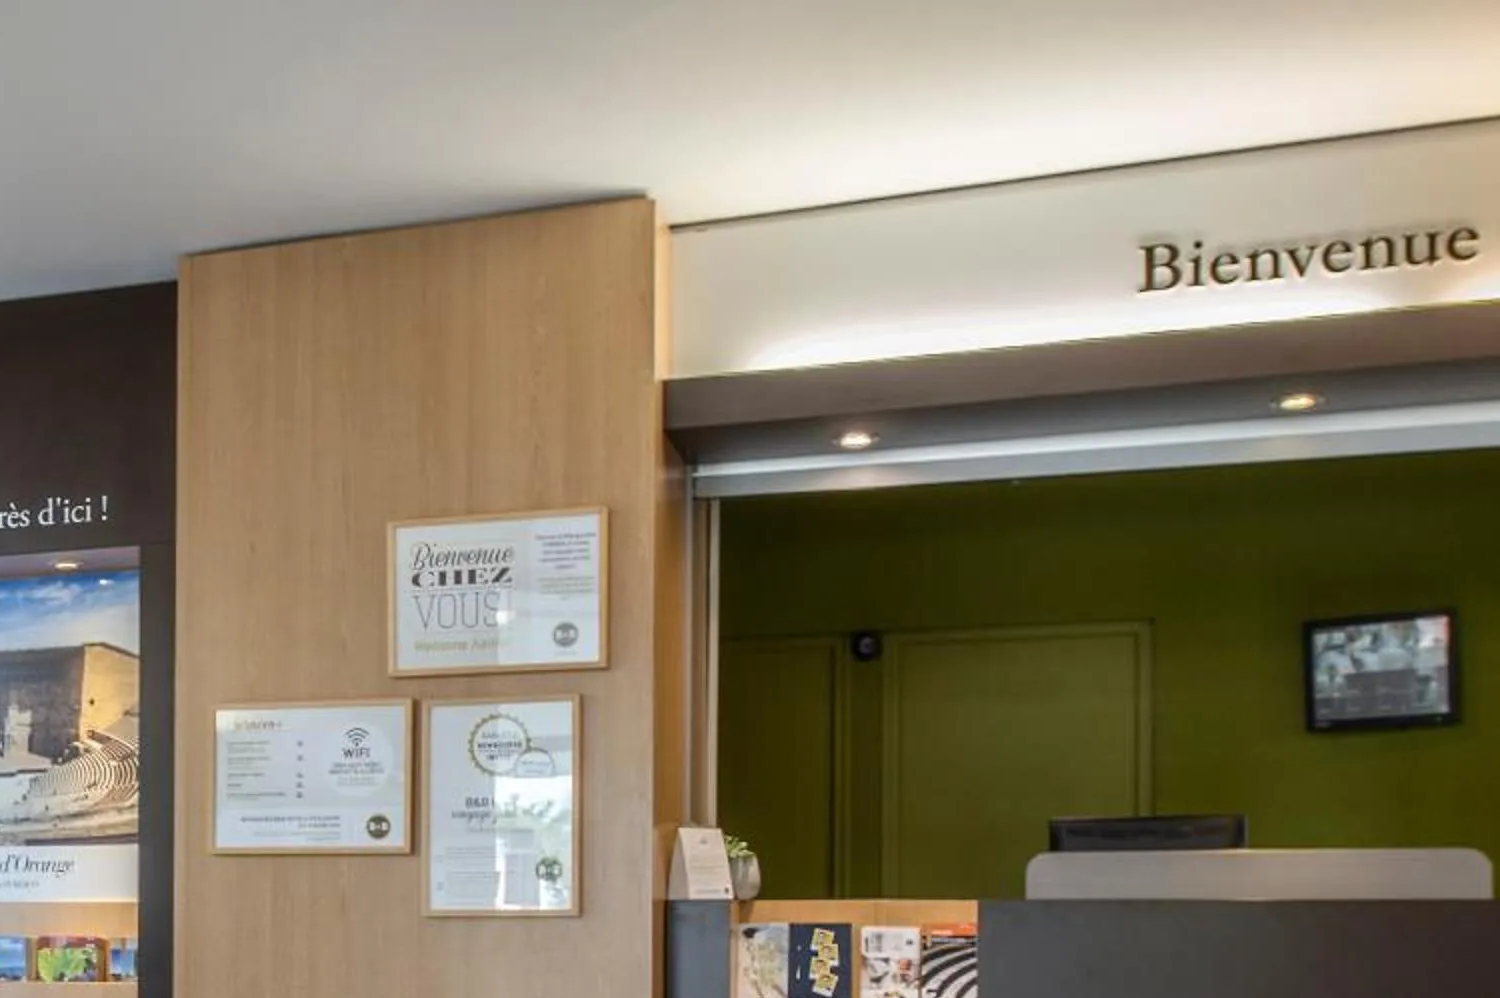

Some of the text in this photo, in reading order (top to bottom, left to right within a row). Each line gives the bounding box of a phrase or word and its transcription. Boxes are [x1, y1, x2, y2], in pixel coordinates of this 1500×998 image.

[1137, 225, 1480, 292] Bienvenue
[38, 496, 92, 525] d'ici
[411, 541, 514, 571] Bienvenue
[411, 567, 513, 588] CHEZ
